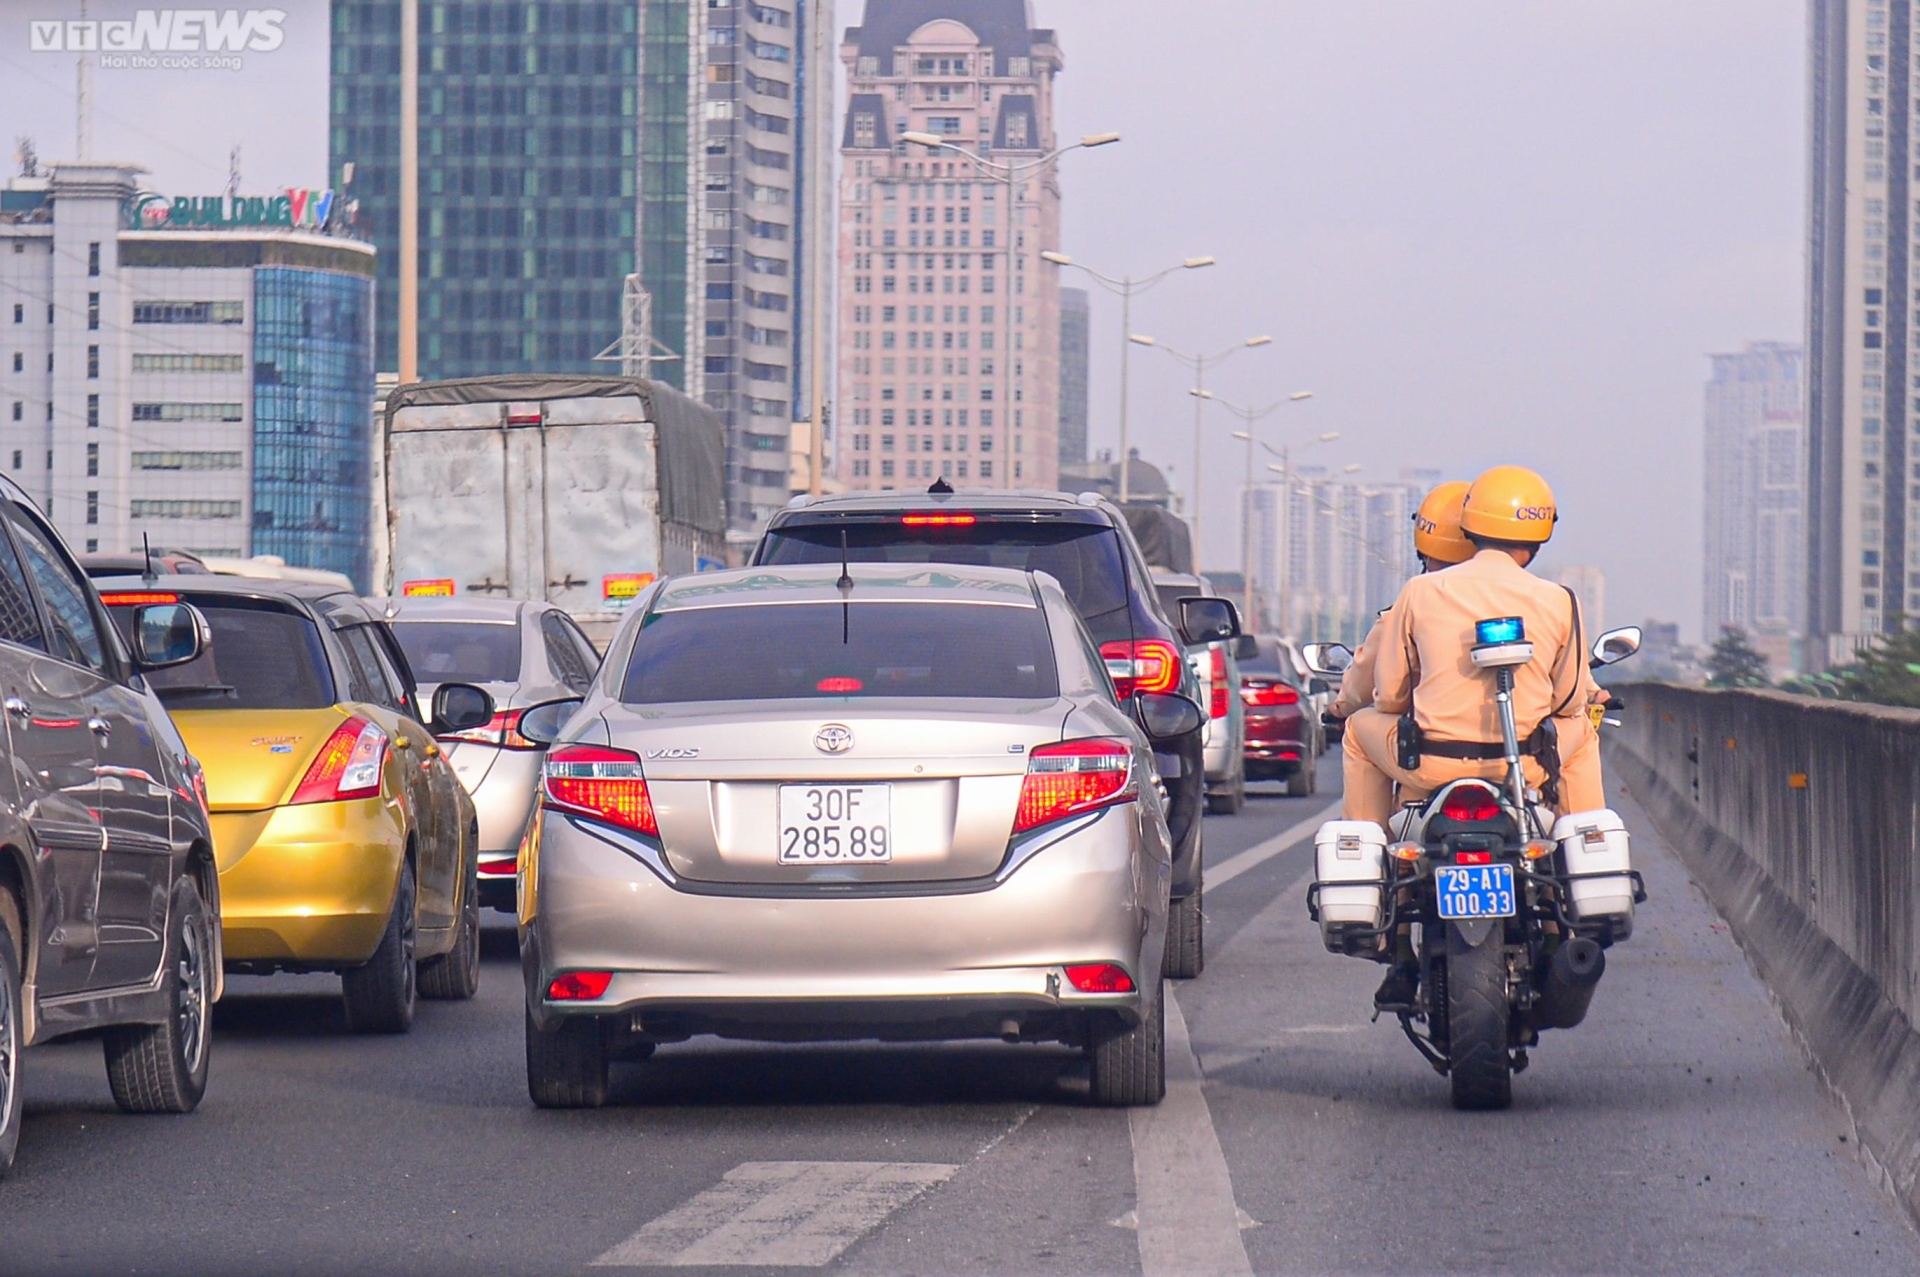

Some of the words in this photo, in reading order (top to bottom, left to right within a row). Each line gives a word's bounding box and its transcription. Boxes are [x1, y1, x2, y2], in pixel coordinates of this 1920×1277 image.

[172, 195, 291, 226] BUILDING
[1515, 506, 1553, 521] CSGT
[645, 748, 700, 760] VIOS
[806, 788, 864, 822] 30F
[783, 825, 888, 859] 285.89
[1447, 868, 1502, 892] 29-A1
[1443, 890, 1511, 915] 100.33
